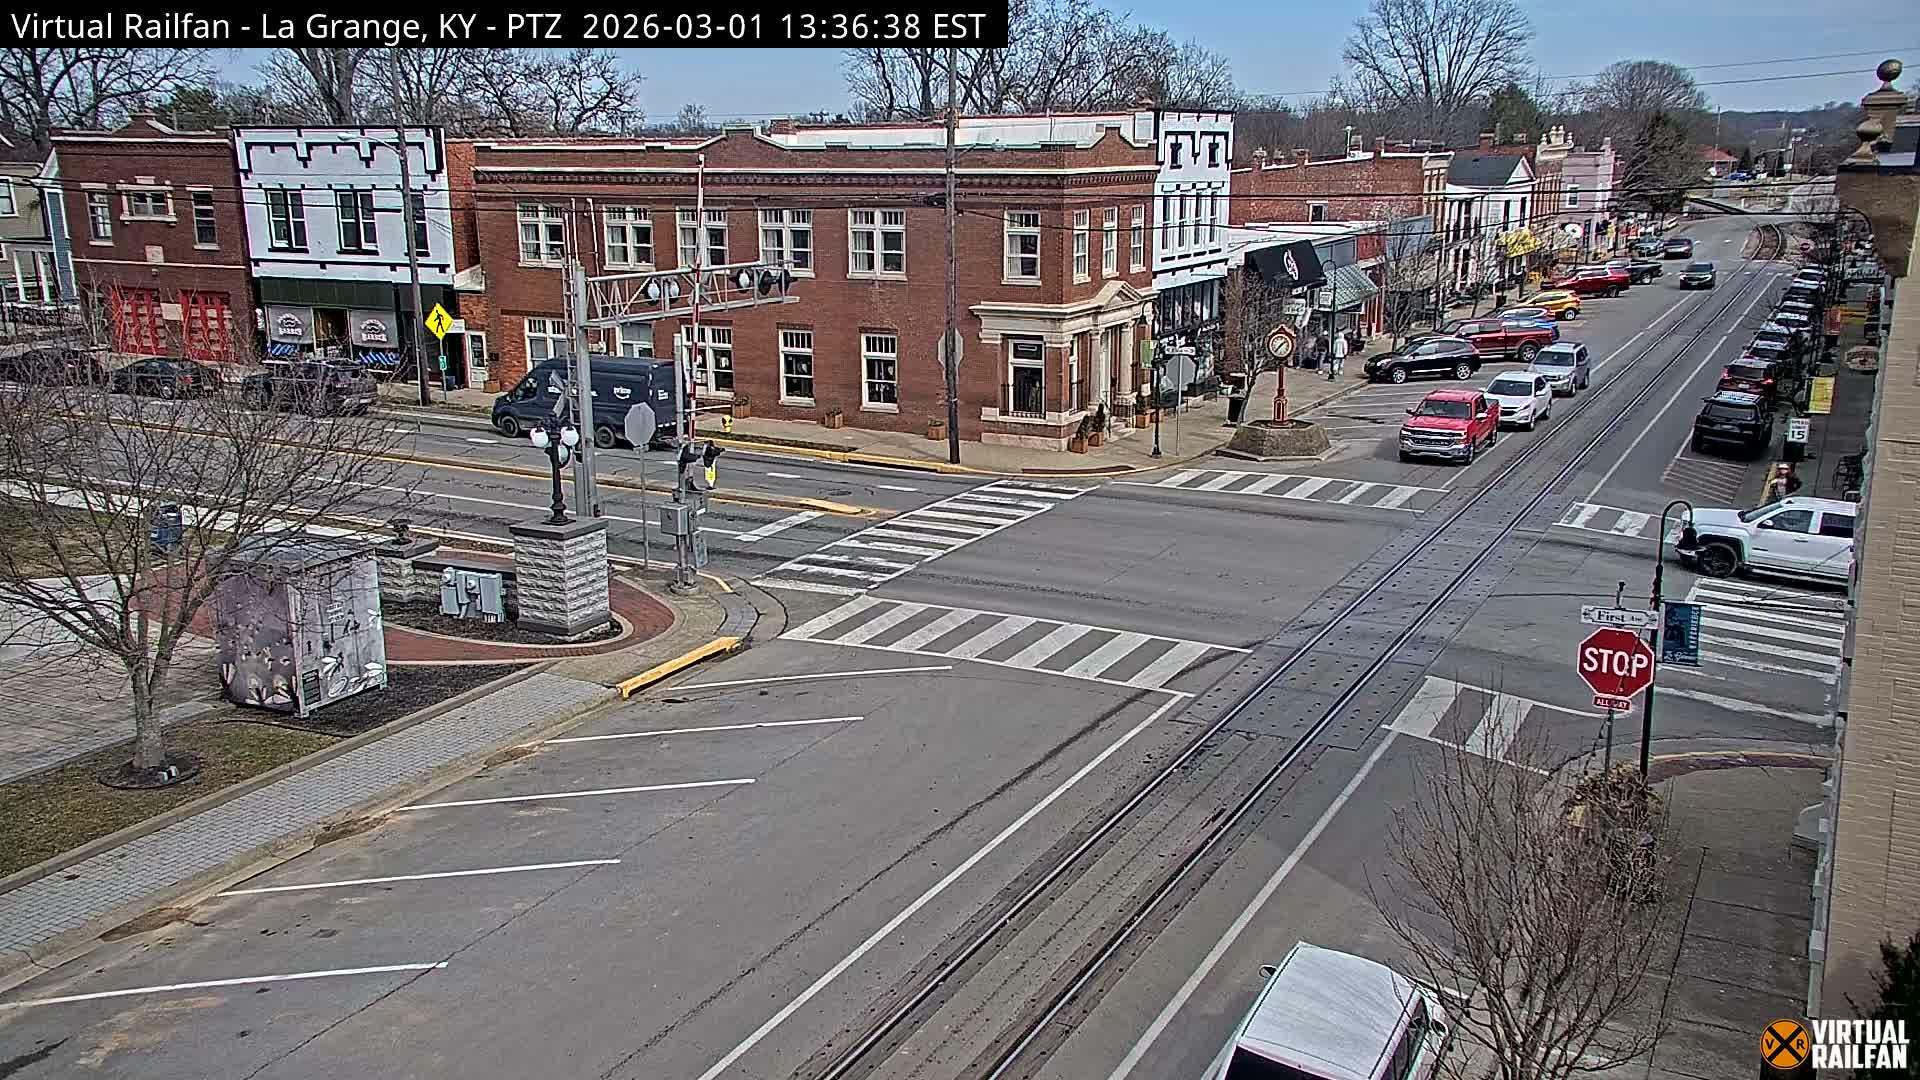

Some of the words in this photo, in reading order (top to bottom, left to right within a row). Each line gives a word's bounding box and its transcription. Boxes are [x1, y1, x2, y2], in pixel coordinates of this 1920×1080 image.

[1791, 430, 1805, 440] 15
[1597, 610, 1626, 623] First
[1582, 646, 1649, 678] STOP
[1596, 698, 1609, 707] ALL
